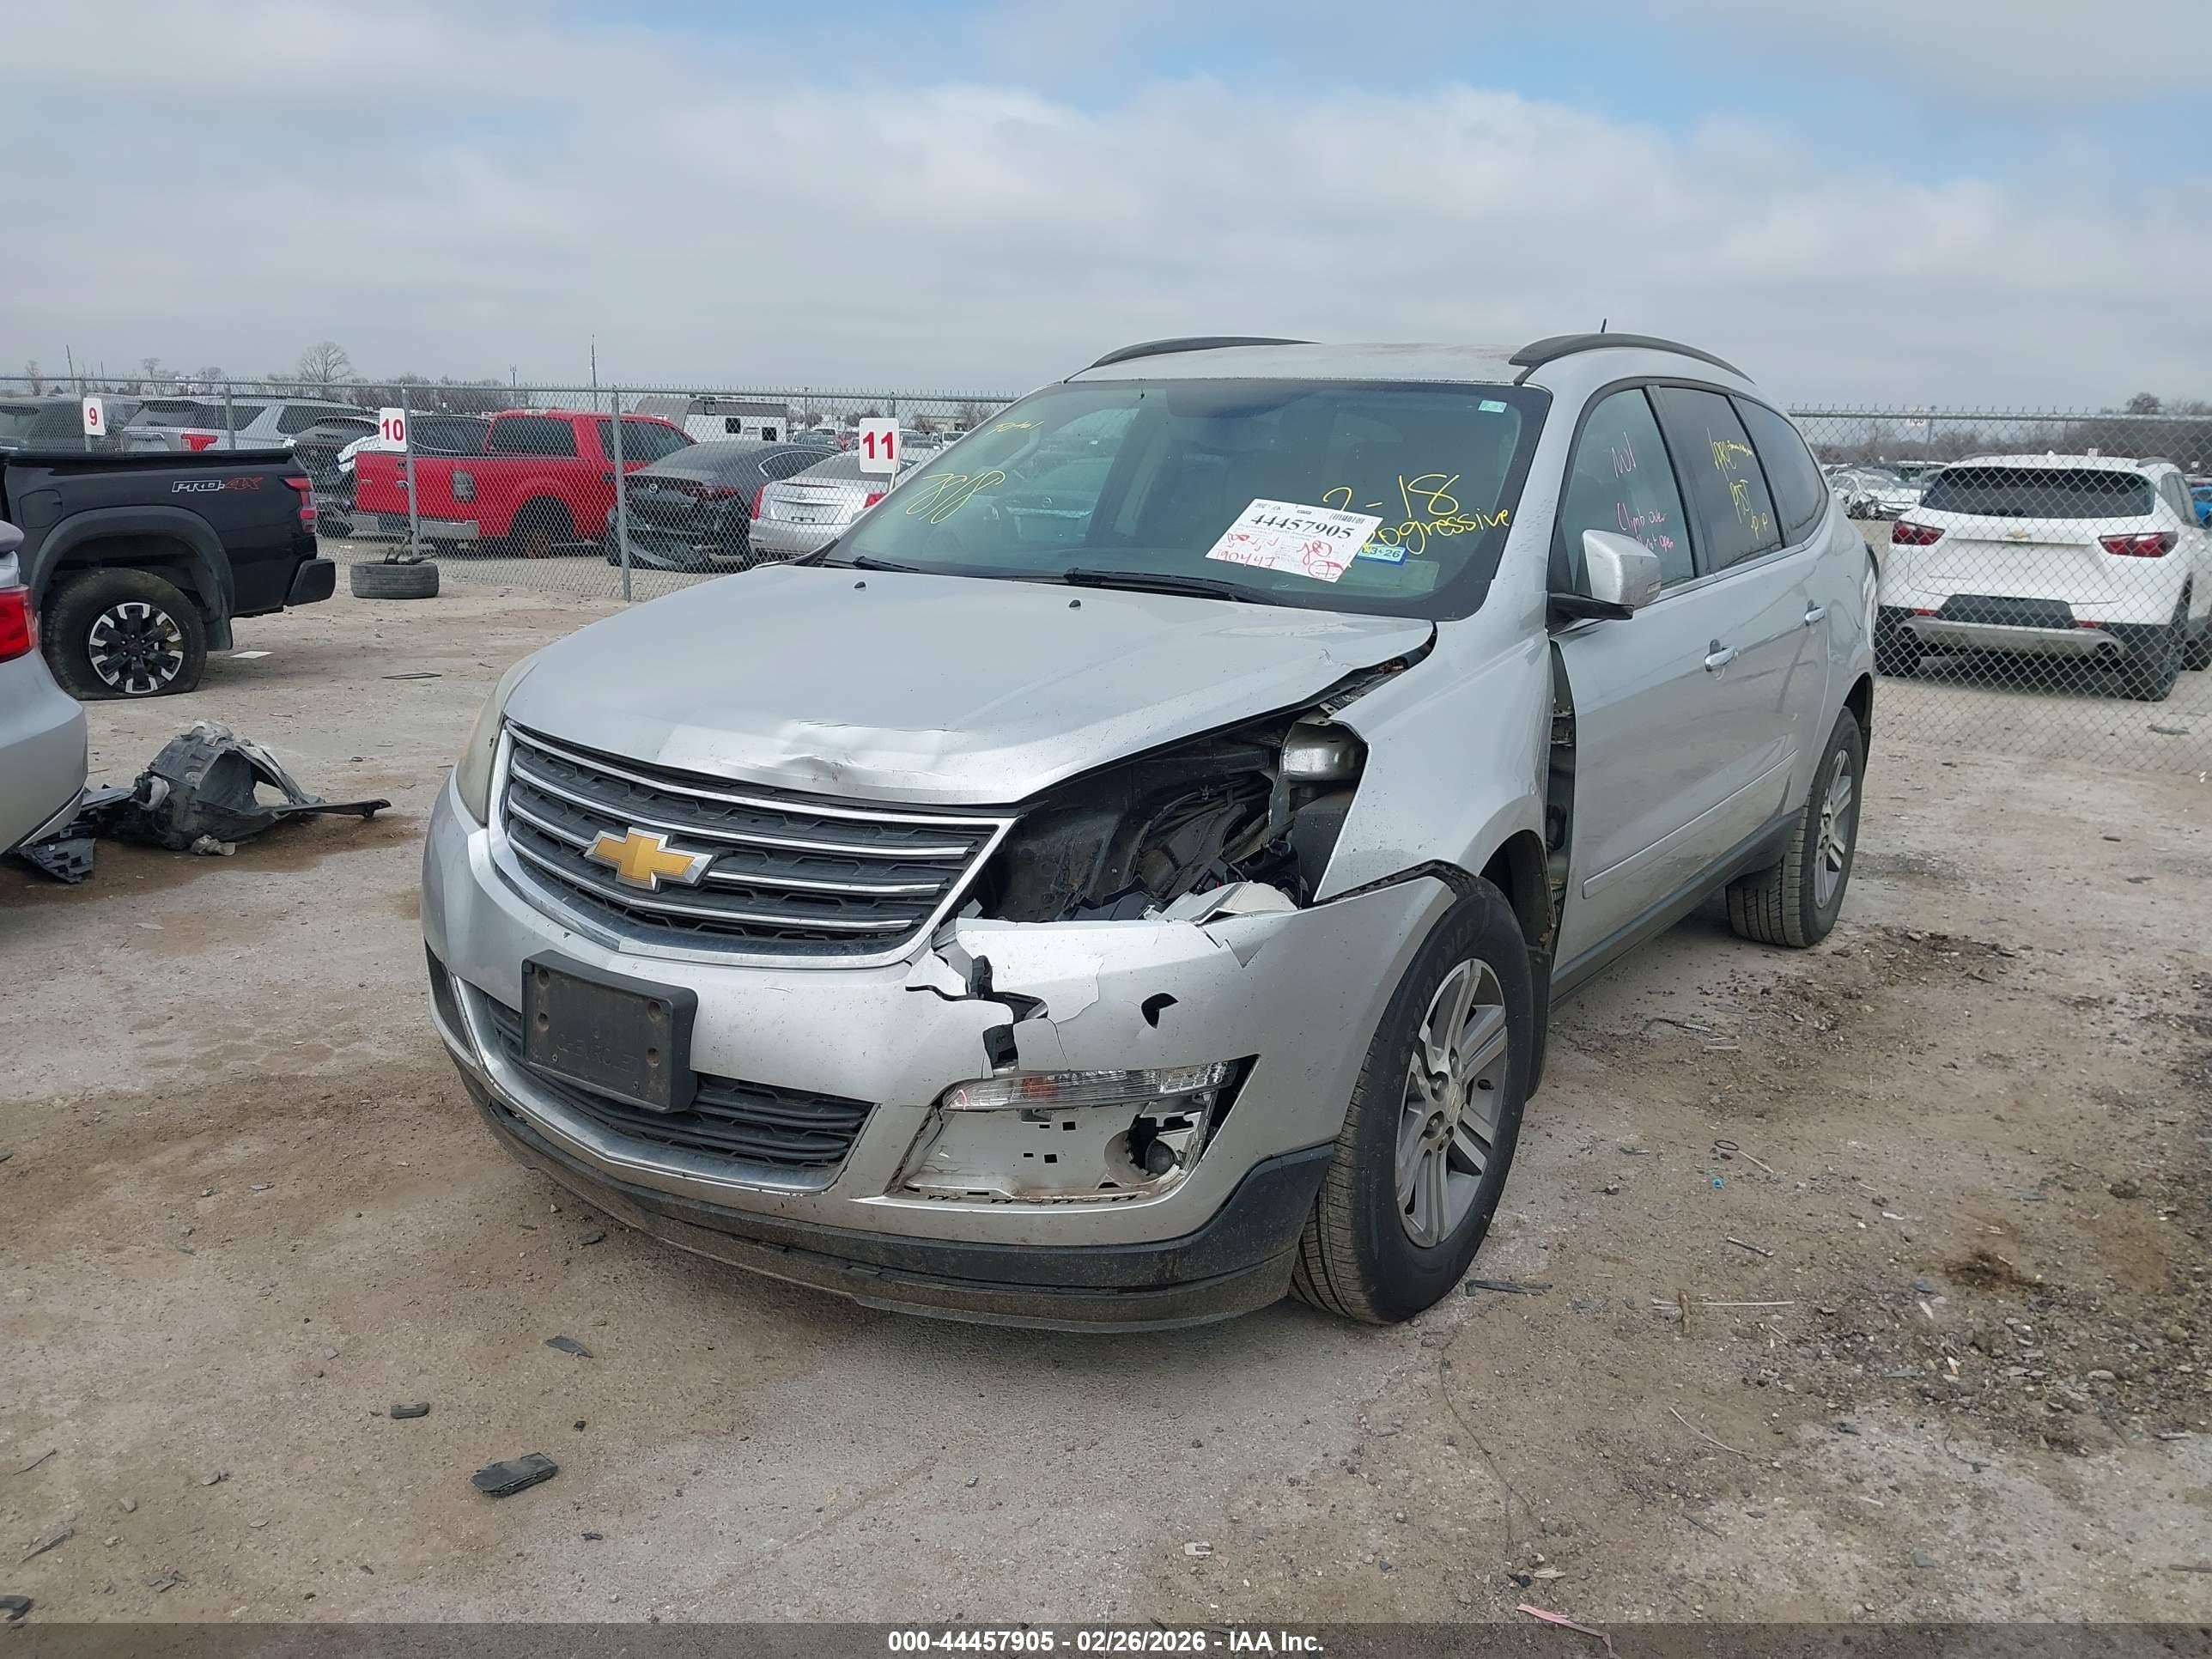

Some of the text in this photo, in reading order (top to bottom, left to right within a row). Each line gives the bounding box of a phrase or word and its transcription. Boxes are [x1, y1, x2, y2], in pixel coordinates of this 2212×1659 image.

[89, 407, 98, 427] 9
[382, 418, 404, 441] 10
[863, 431, 894, 459] 11
[1250, 514, 1355, 540] 44457905
